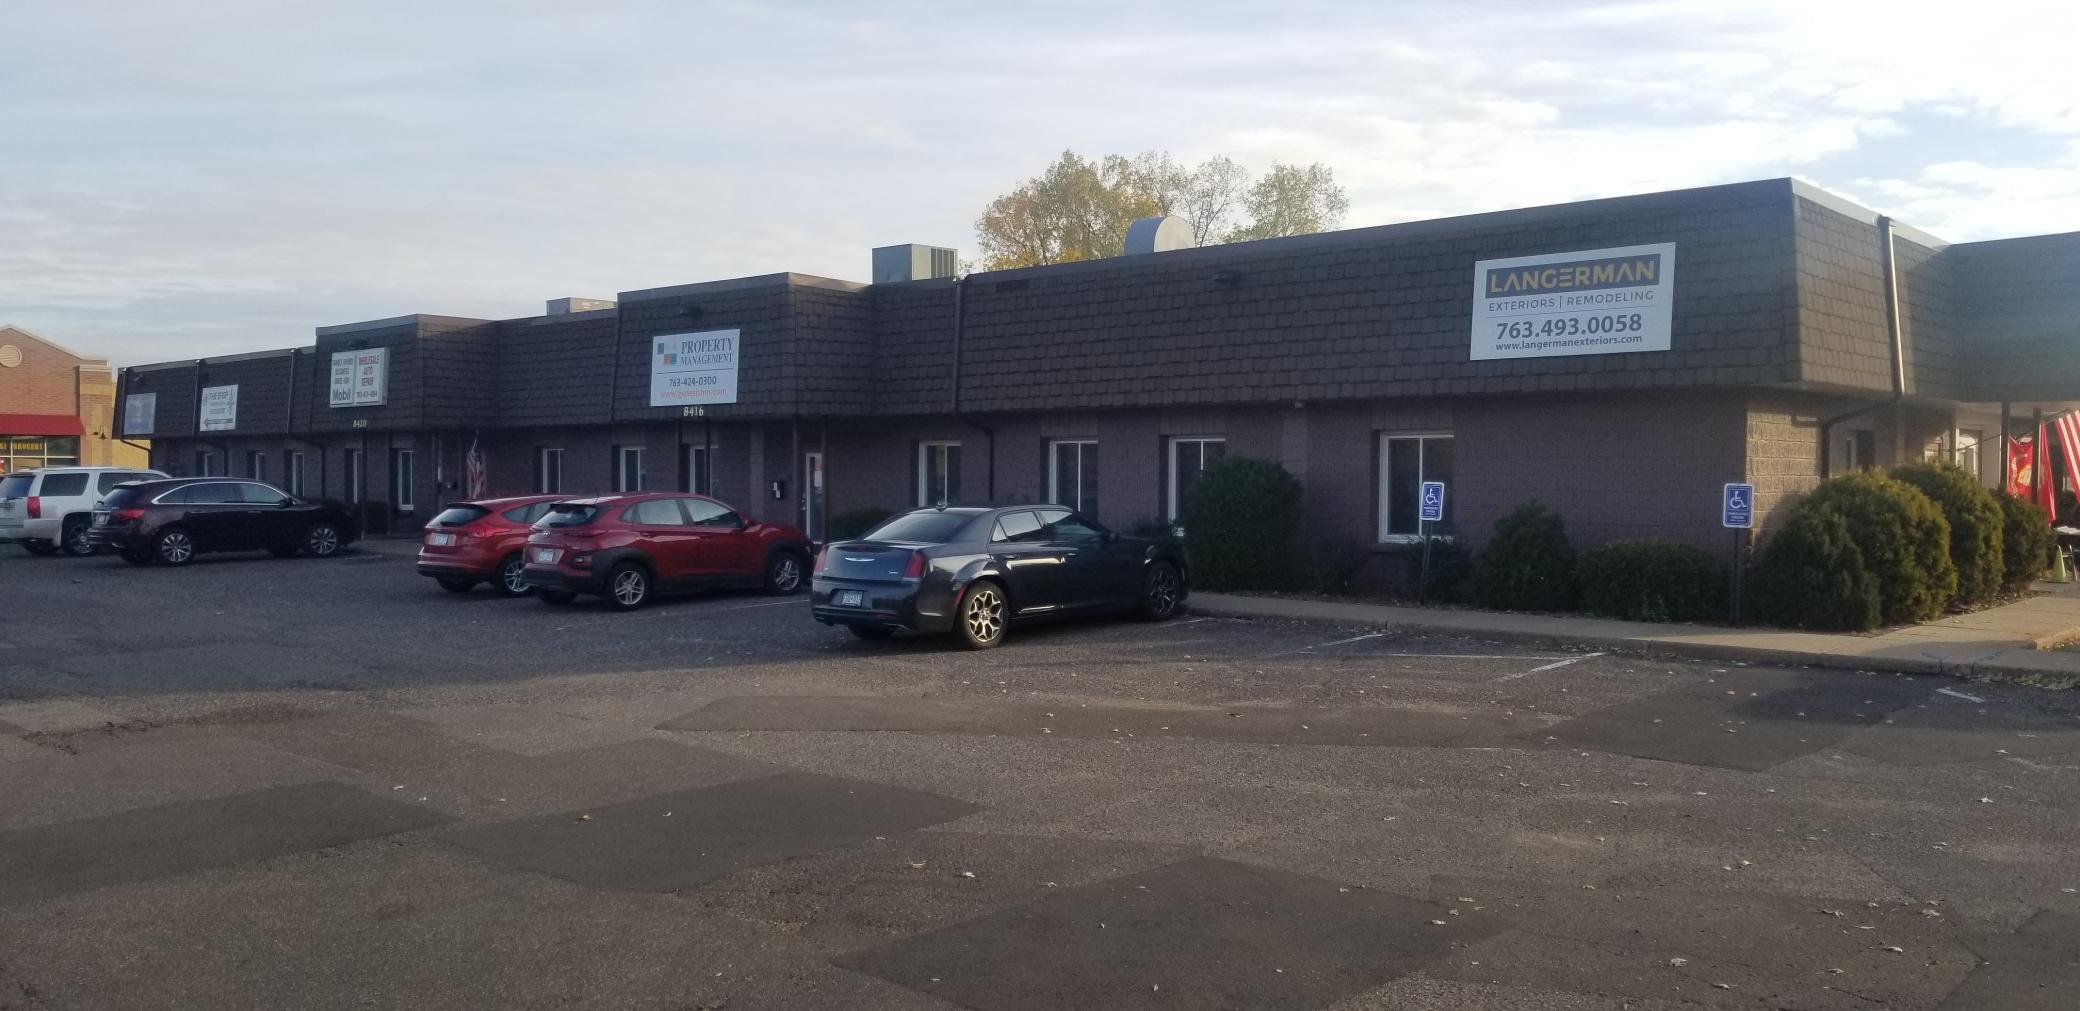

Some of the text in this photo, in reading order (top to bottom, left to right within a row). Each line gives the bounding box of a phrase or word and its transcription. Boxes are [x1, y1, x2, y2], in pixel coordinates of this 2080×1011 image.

[1490, 260, 1655, 293] LANGERMAN
[1489, 290, 1654, 312] EXTERIORS REMODELING
[1496, 313, 1643, 340] 763.493.0058
[681, 337, 735, 354] PROPERTY
[1495, 334, 1643, 352] www.langermanexteriors.com
[680, 353, 734, 366] MANAGEMENT
[669, 376, 717, 388] 763-424-0300
[332, 388, 351, 401] Mobil
[683, 406, 704, 417] 8416
